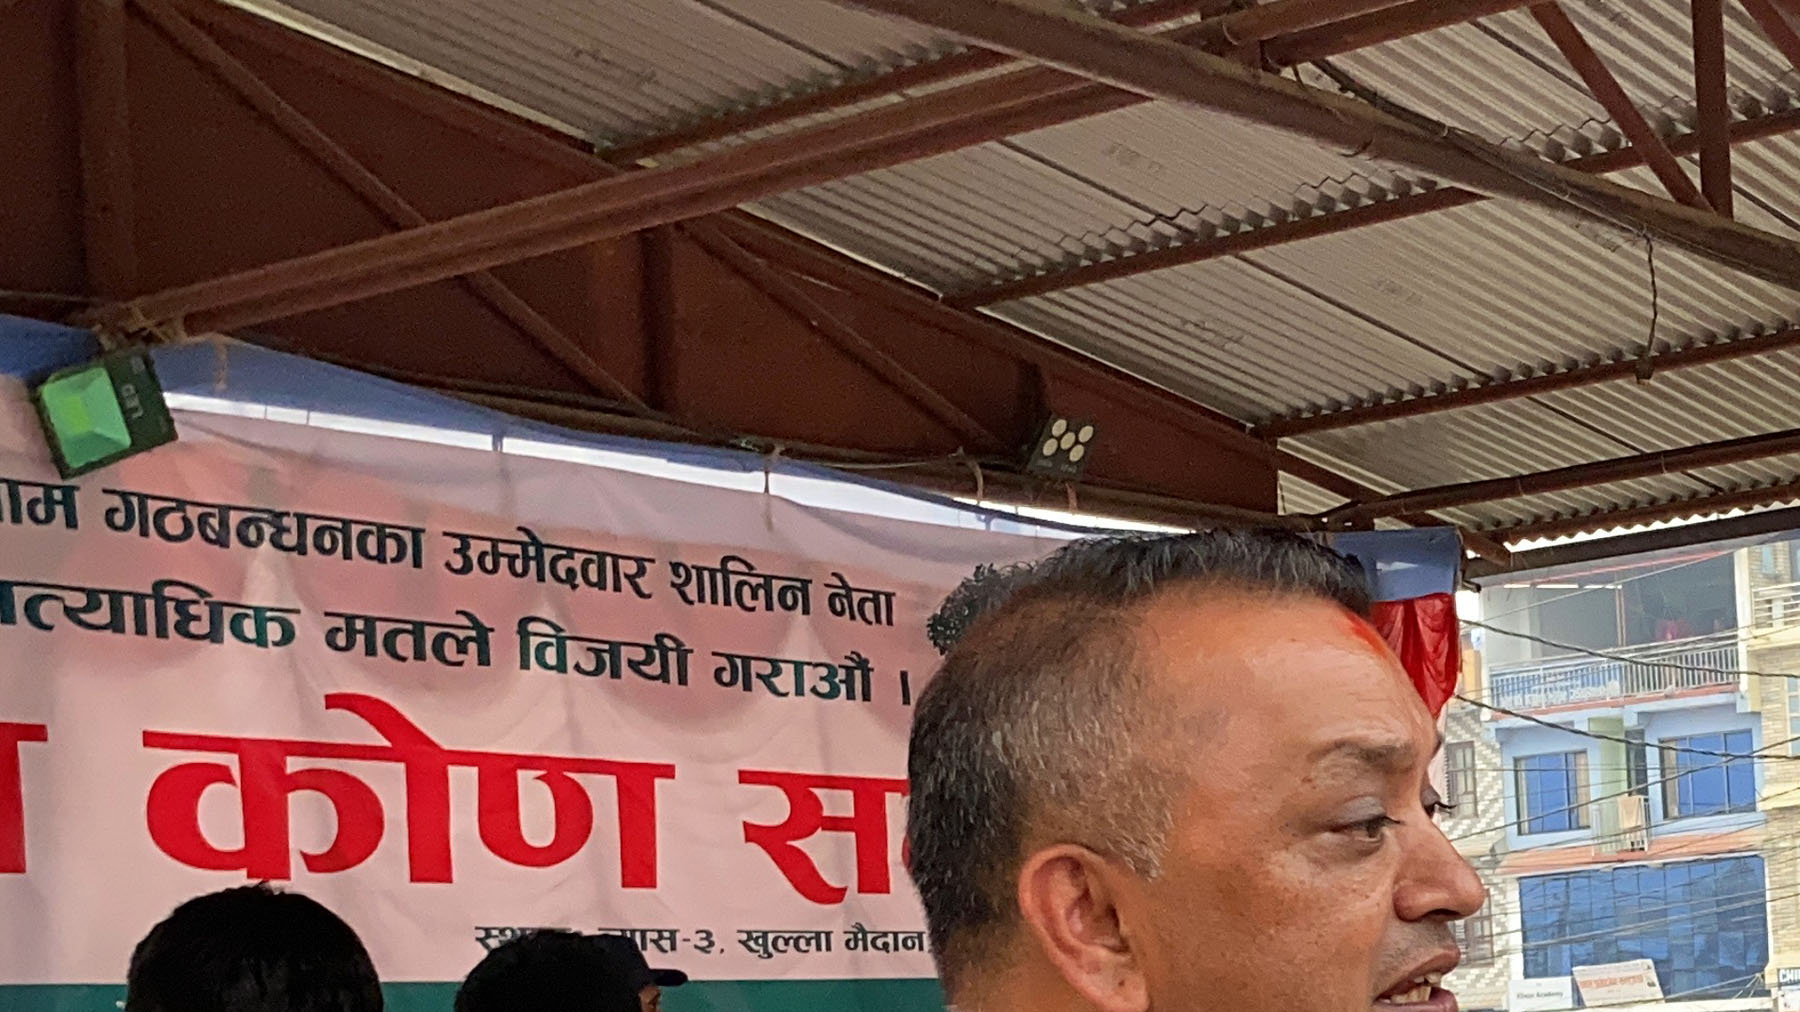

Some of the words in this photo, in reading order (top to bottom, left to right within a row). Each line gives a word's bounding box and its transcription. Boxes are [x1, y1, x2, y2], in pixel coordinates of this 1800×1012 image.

[0, 477, 80, 530] ाम
[102, 487, 426, 569] गठबन्धनका
[444, 525, 656, 599] उम्मेदवार
[669, 554, 813, 616] शालिन
[824, 572, 896, 627] नेता
[324, 610, 495, 667] मतले
[516, 616, 693, 686] विजयी
[142, 691, 675, 890] कोण
[738, 768, 910, 906] स
[736, 929, 834, 960] खुल्ला
